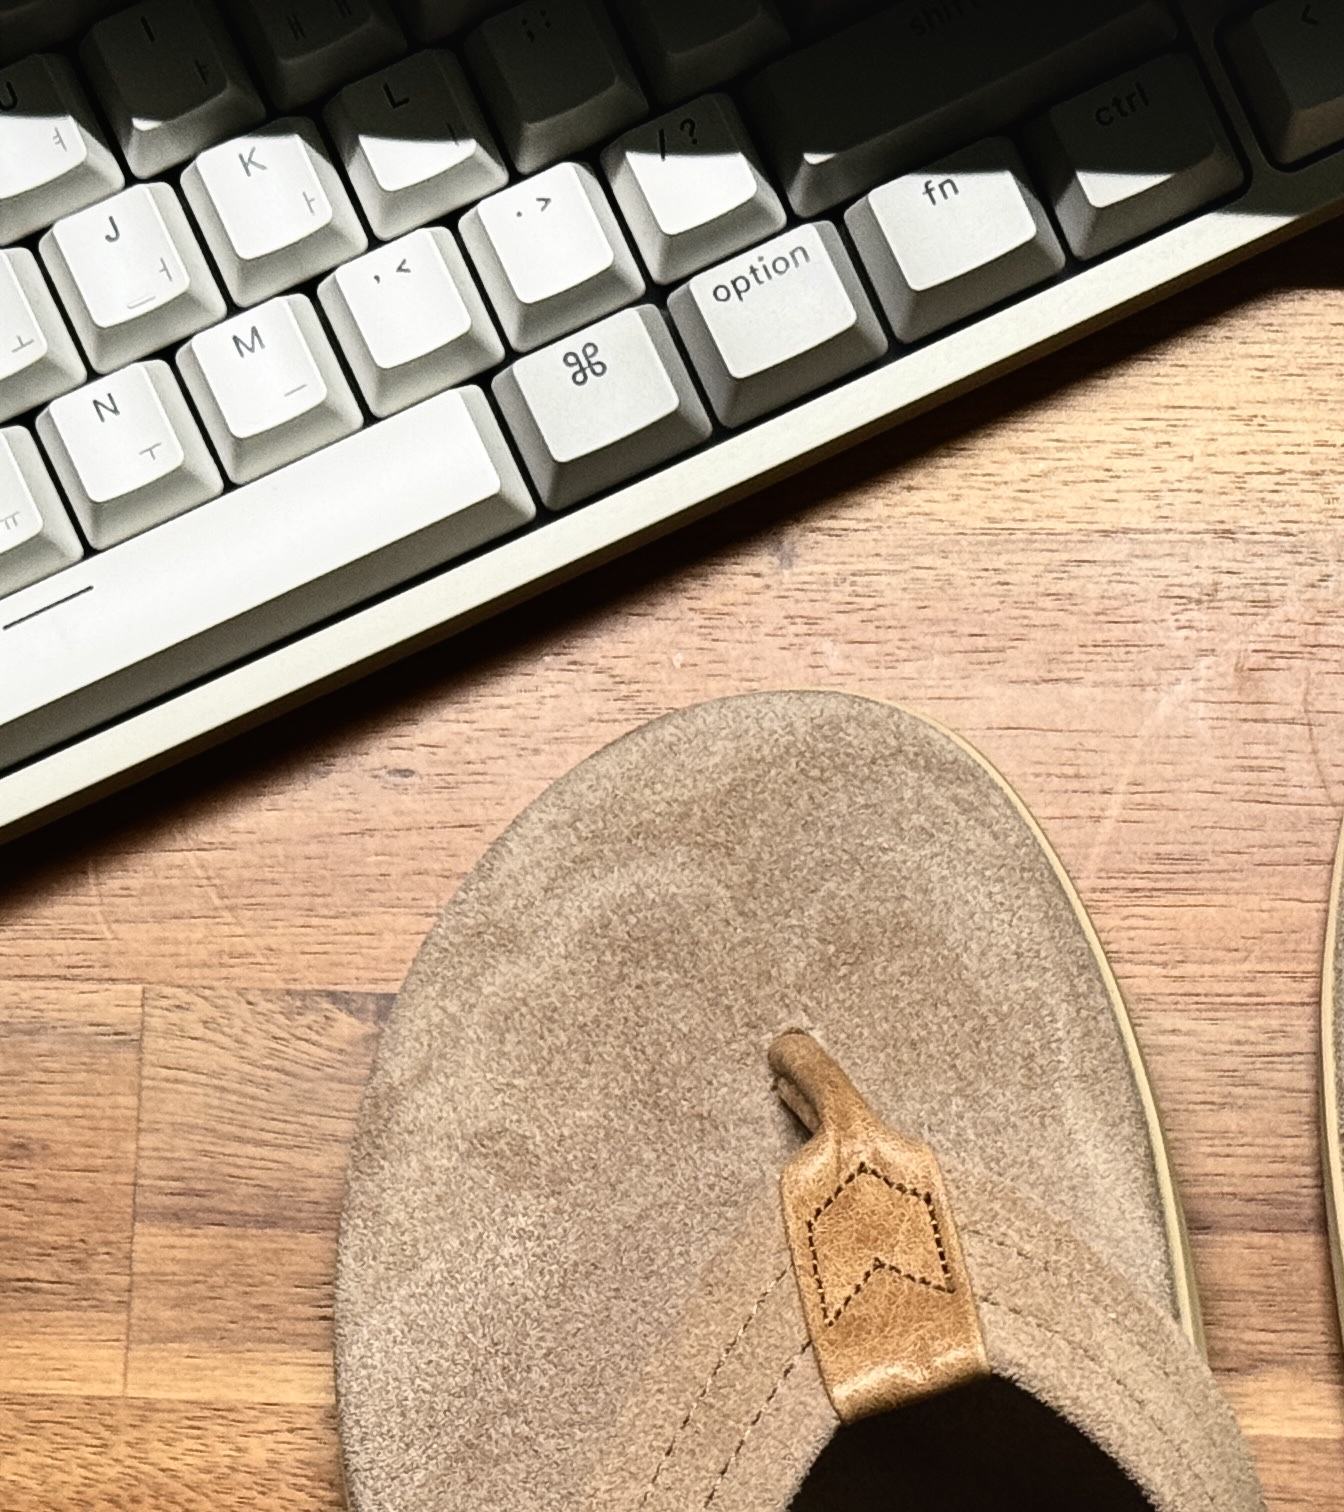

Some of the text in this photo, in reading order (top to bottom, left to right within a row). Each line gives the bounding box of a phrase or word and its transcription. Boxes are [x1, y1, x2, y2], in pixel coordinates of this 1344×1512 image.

[383, 83, 409, 108] L
[1094, 81, 1150, 127] ctrl
[239, 147, 267, 177] K
[921, 175, 960, 207] fn
[105, 216, 119, 242] J
[712, 244, 811, 303] option
[12, 336, 34, 352] ㅗ
[232, 326, 264, 357] M
[93, 393, 119, 422] N
[139, 443, 161, 460] ㅜ
